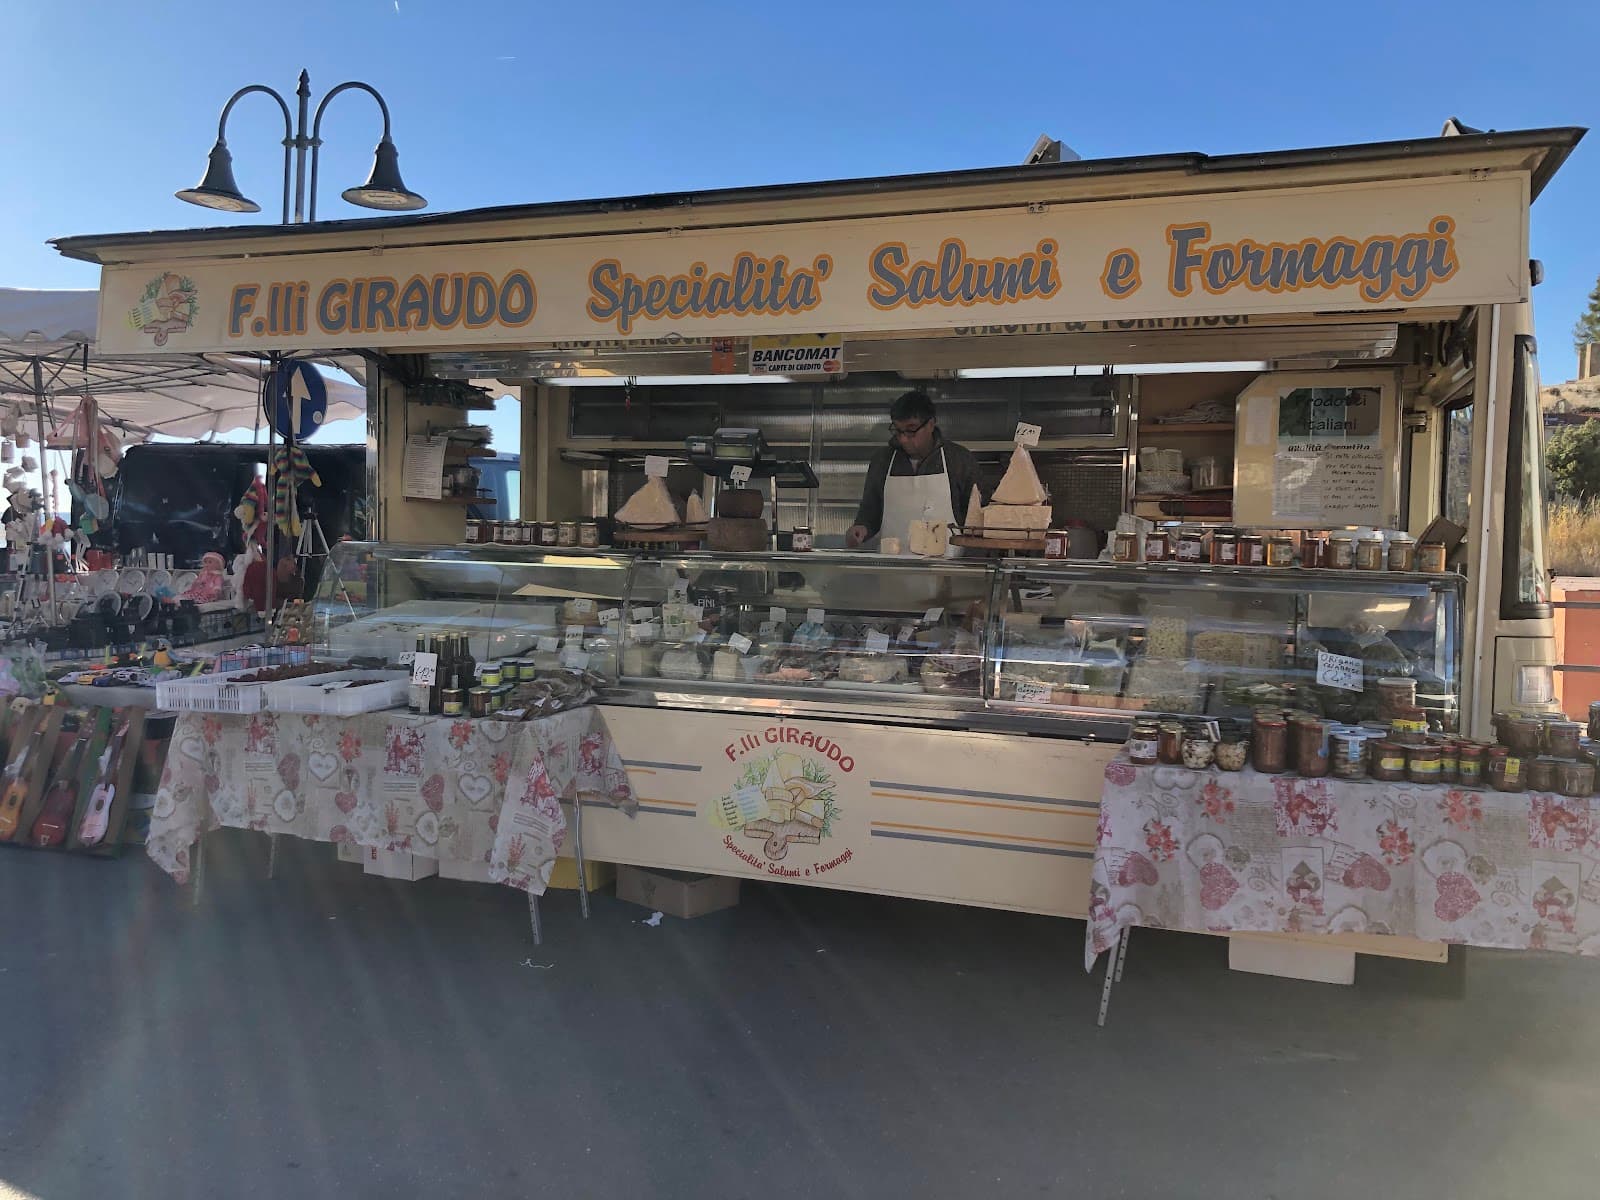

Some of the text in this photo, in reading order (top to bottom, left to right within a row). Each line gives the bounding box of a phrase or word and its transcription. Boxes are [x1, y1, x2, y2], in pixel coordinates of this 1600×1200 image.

[229, 215, 1459, 336] F.lli GIRAUDO Specialita' Salumi e Formaggi
[752, 348, 840, 362] BANCOMAT
[769, 364, 787, 372] CARTE
[796, 363, 821, 371] CREDITO
[764, 726, 855, 773] GIRAUDO
[723, 834, 766, 869] Specialita'
[767, 863, 801, 877] Salumi
[813, 847, 854, 876] Formaggi
